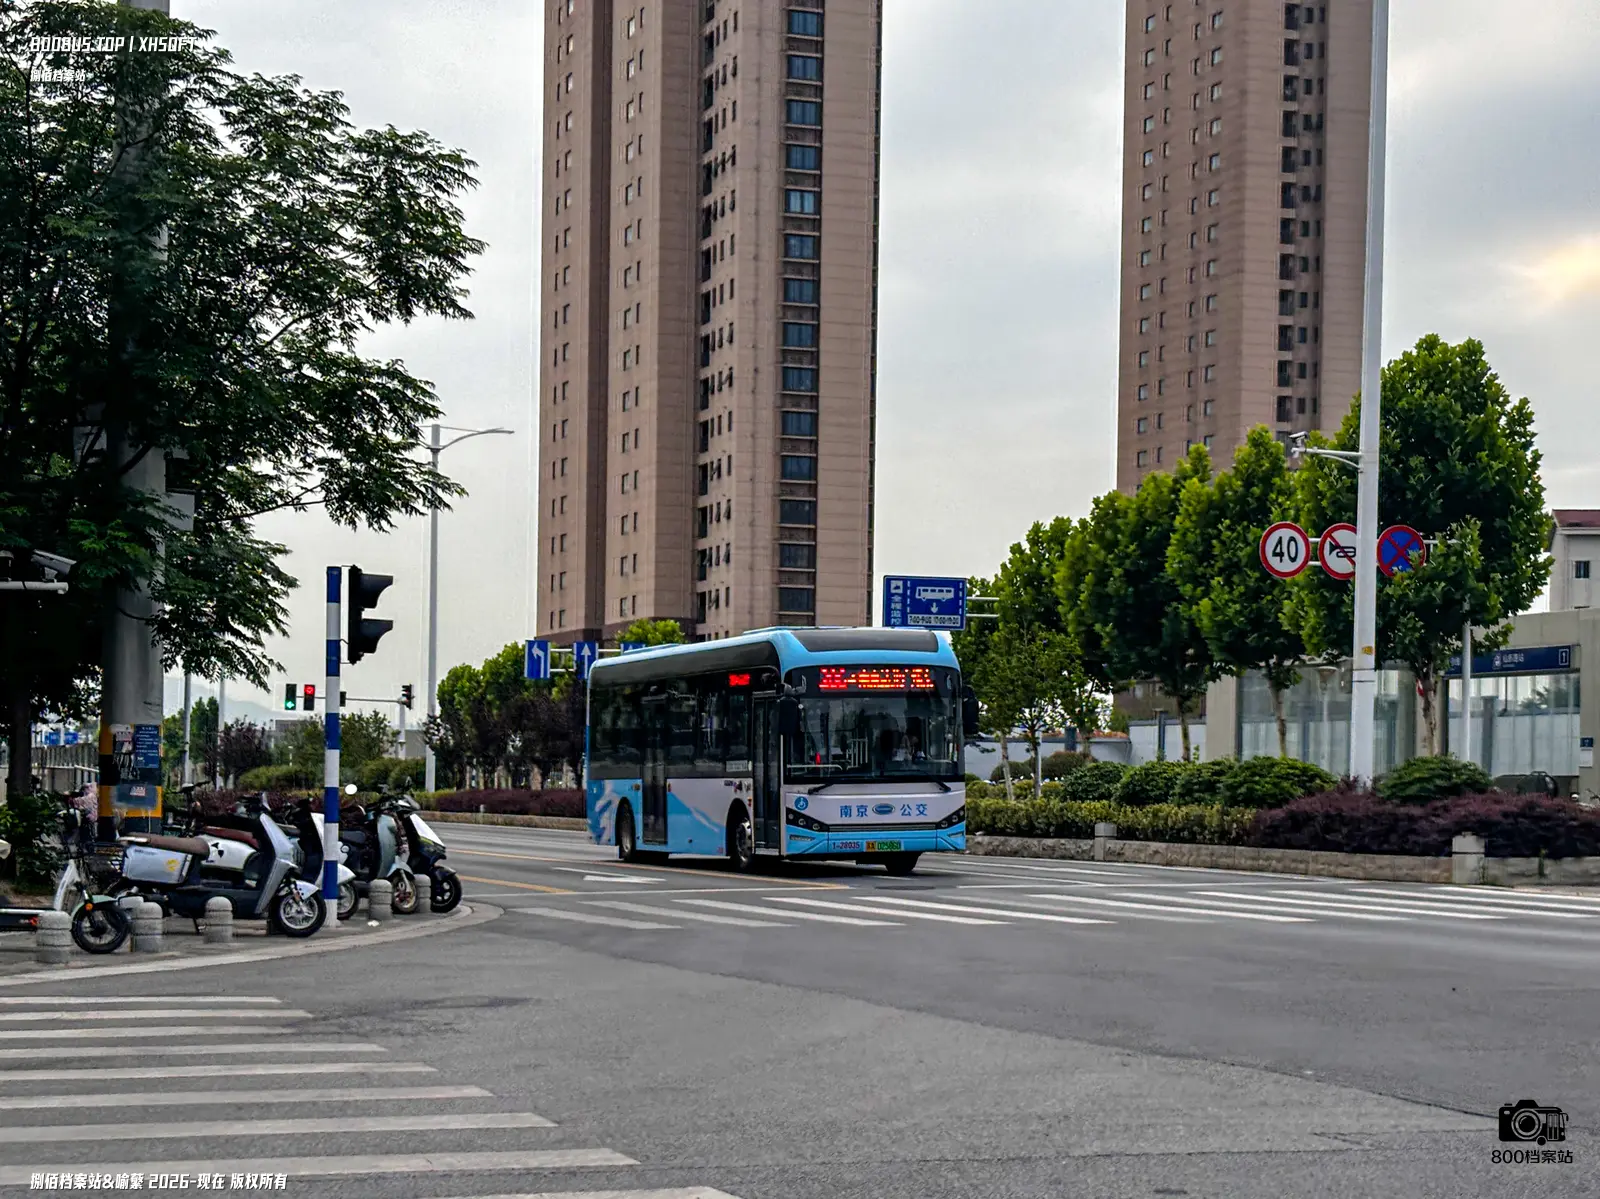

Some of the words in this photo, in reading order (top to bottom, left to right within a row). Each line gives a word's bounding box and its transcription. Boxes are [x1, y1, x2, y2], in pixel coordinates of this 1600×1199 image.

[1271, 536, 1299, 563] 40
[839, 804, 869, 818] 南京
[900, 803, 928, 817] 公交
